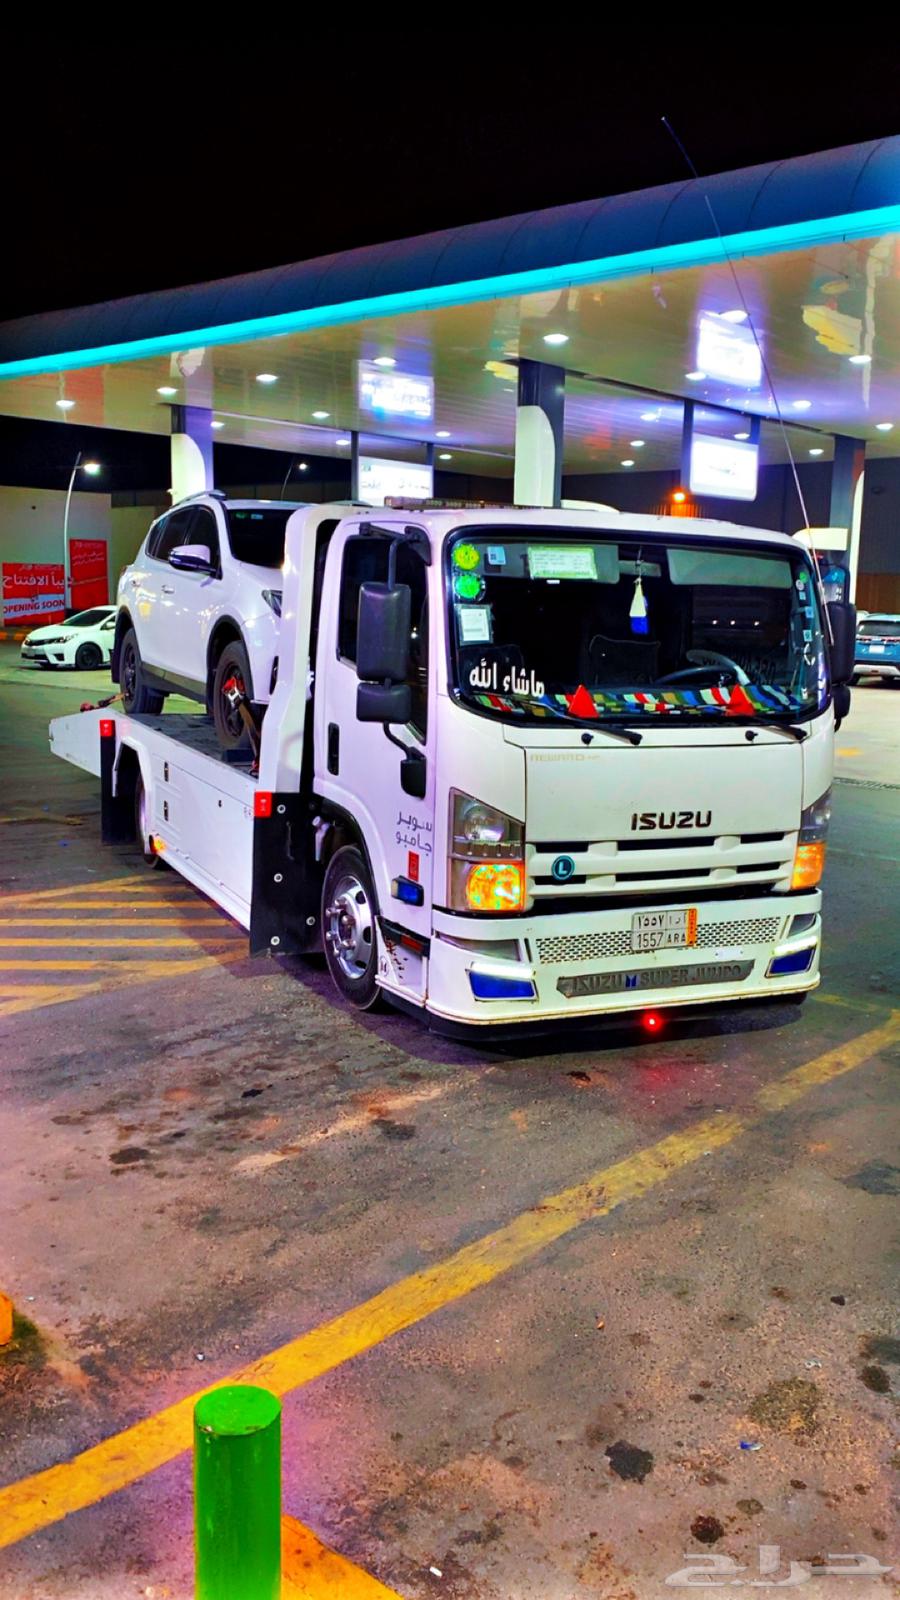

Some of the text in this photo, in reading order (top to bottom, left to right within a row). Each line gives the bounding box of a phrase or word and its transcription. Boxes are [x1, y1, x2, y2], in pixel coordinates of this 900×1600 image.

[3, 600, 65, 613] OPENING SOON
[469, 658, 545, 698] ماشاء الله
[397, 811, 432, 831] سوبر
[631, 811, 712, 831] ISUZU
[395, 831, 432, 856] جامبو
[637, 932, 686, 948] 1557 ARA
[572, 973, 623, 992] ISUZU
[640, 968, 689, 987] SUPER
